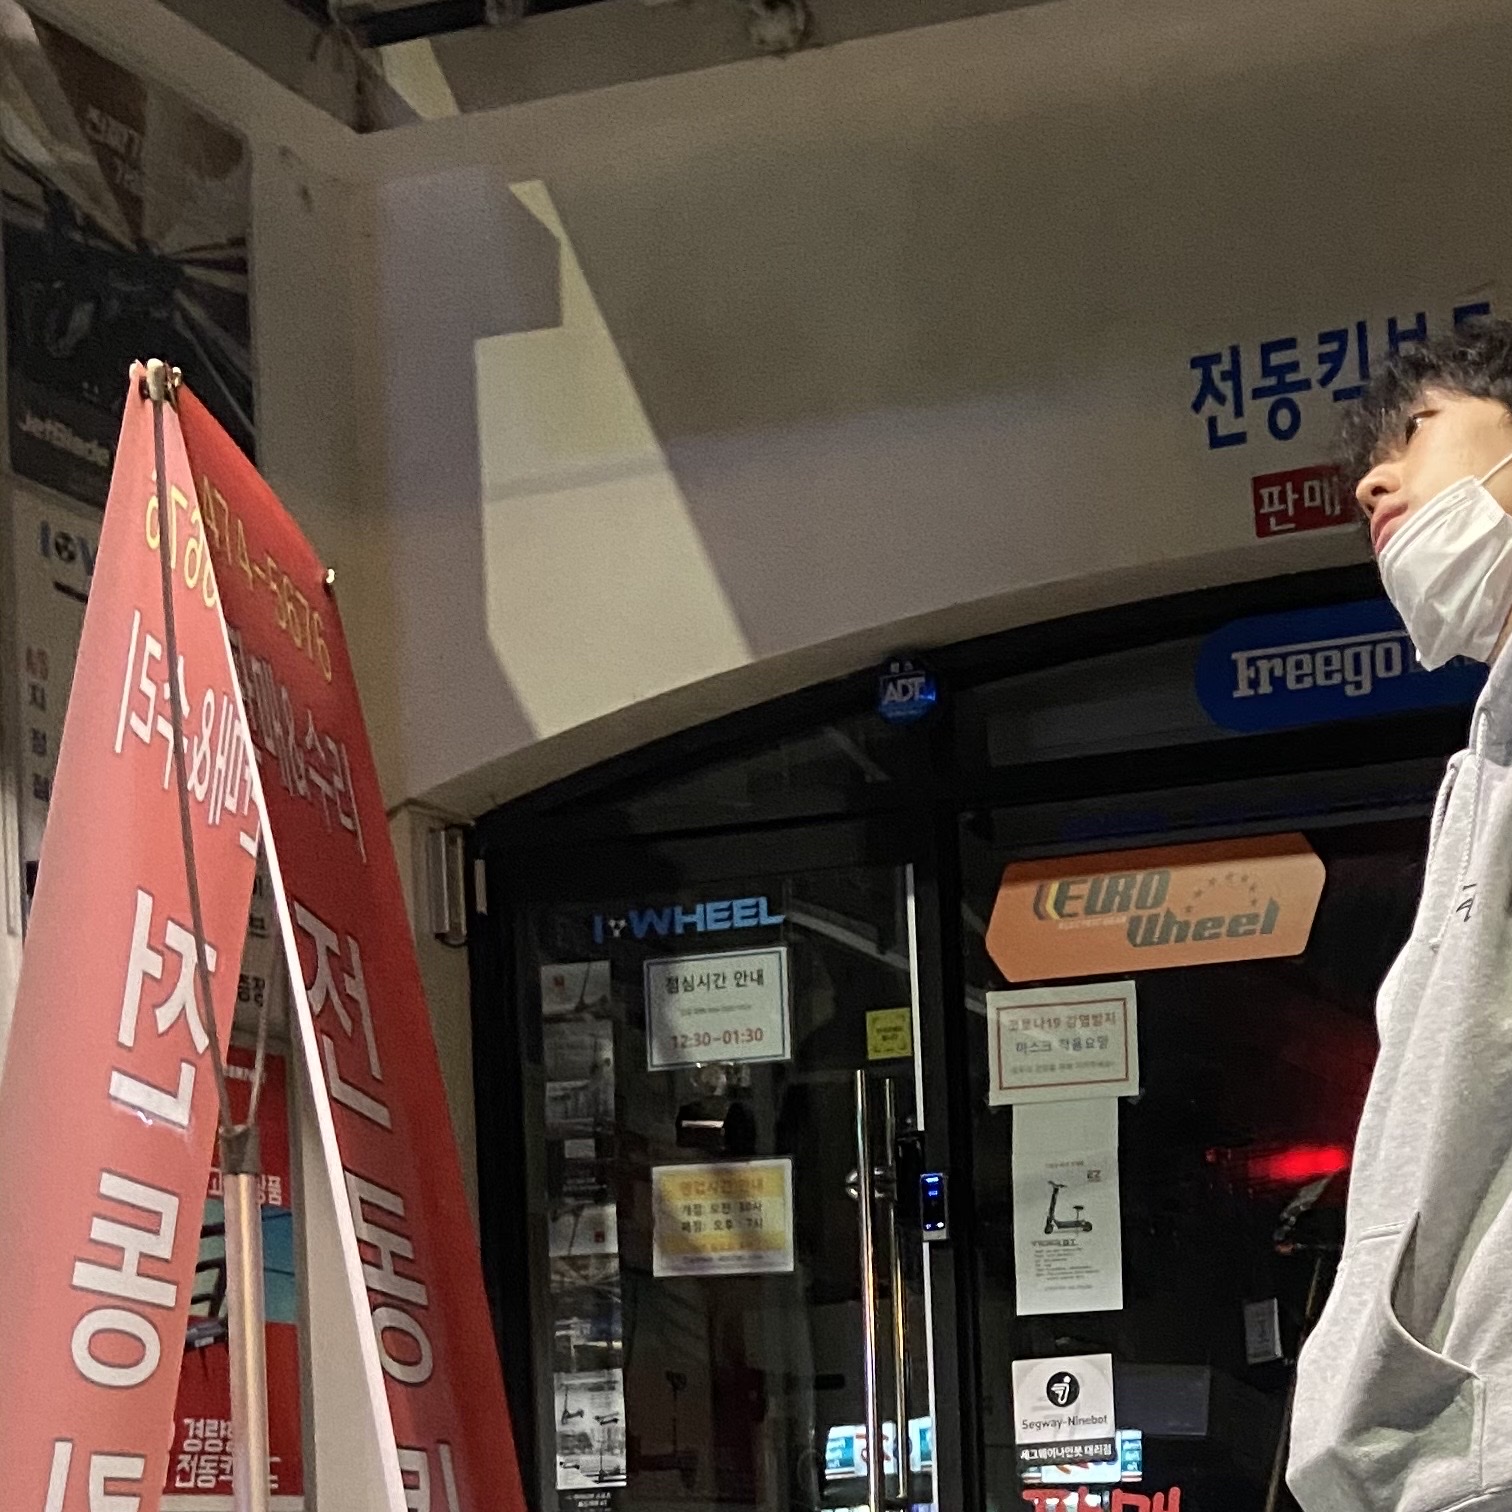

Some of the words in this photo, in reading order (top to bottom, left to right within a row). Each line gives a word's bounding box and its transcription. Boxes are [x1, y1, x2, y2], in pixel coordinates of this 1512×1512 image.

[1231, 630, 1408, 698] Freego
[666, 972, 727, 995] 점심시간
[733, 969, 764, 989] 안내
[1022, 1415, 1108, 1430] Segway-Ninebot
